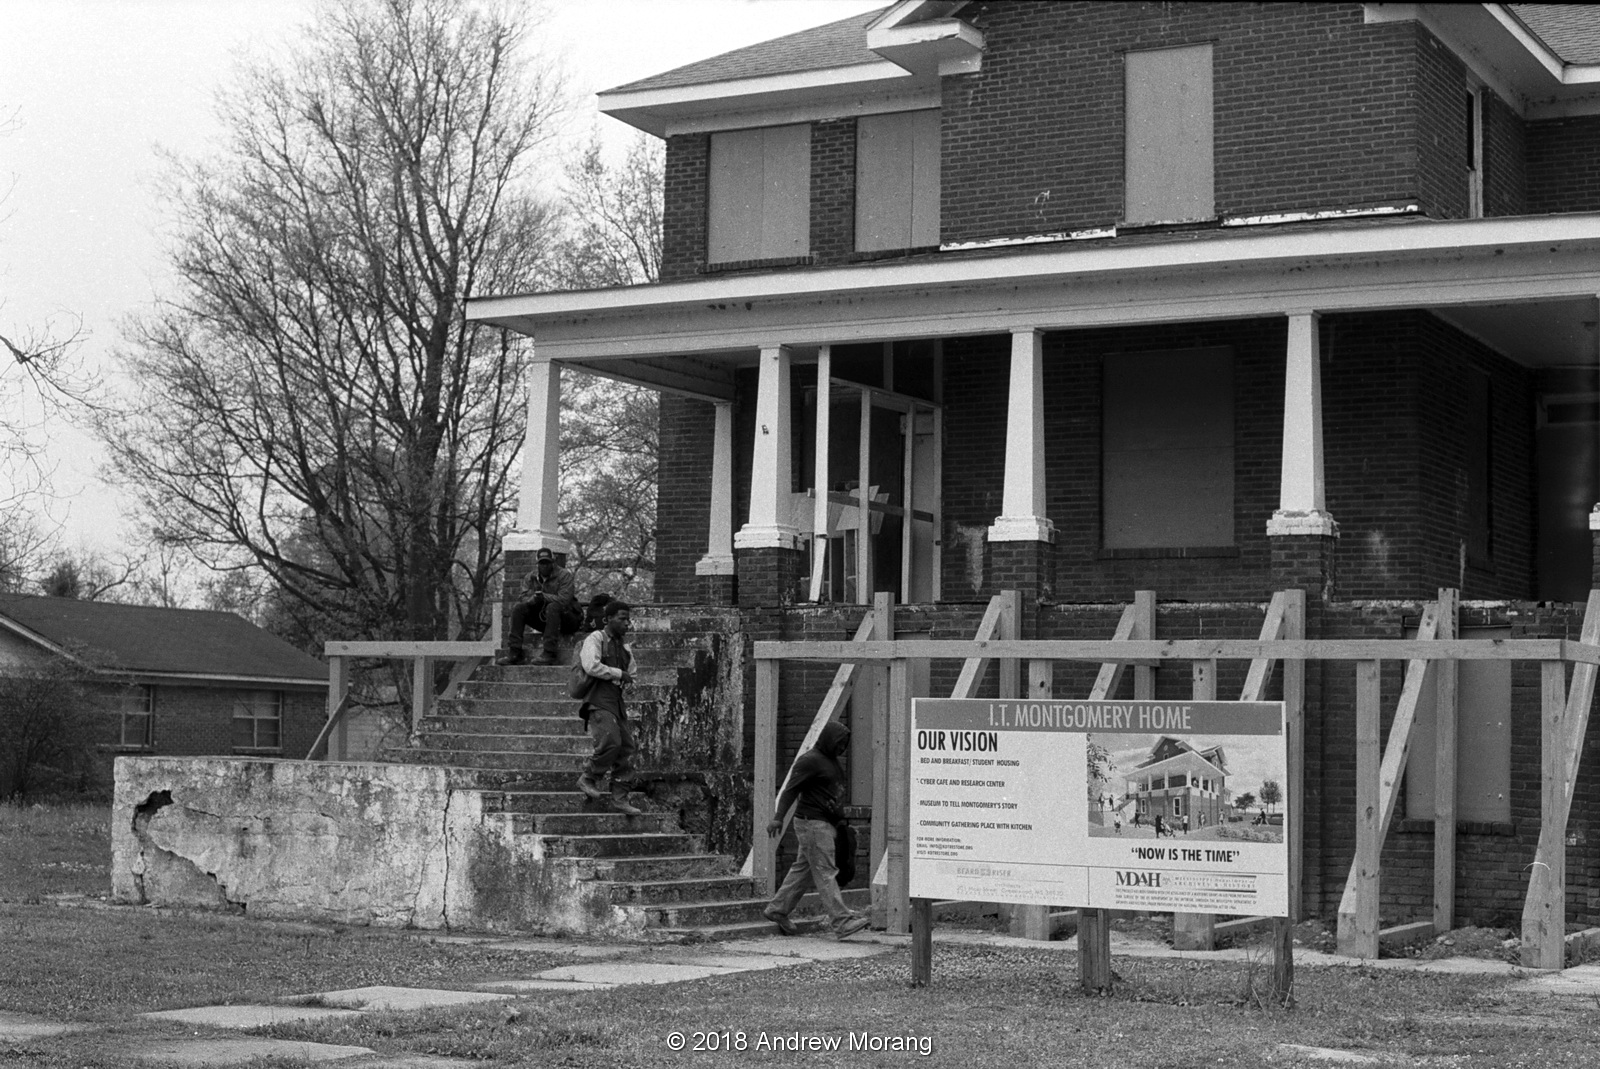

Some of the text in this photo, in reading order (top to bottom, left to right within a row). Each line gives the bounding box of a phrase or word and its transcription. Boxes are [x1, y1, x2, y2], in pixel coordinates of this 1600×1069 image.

[989, 704, 1192, 729] I.T. MONTGOMERY HOME
[917, 730, 998, 752] OUR VISION
[961, 801, 1001, 809] MONTGOMERY'S
[1168, 848, 1179, 860] IS
[1182, 849, 1202, 861] THE
[1115, 871, 1161, 887] MDAH
